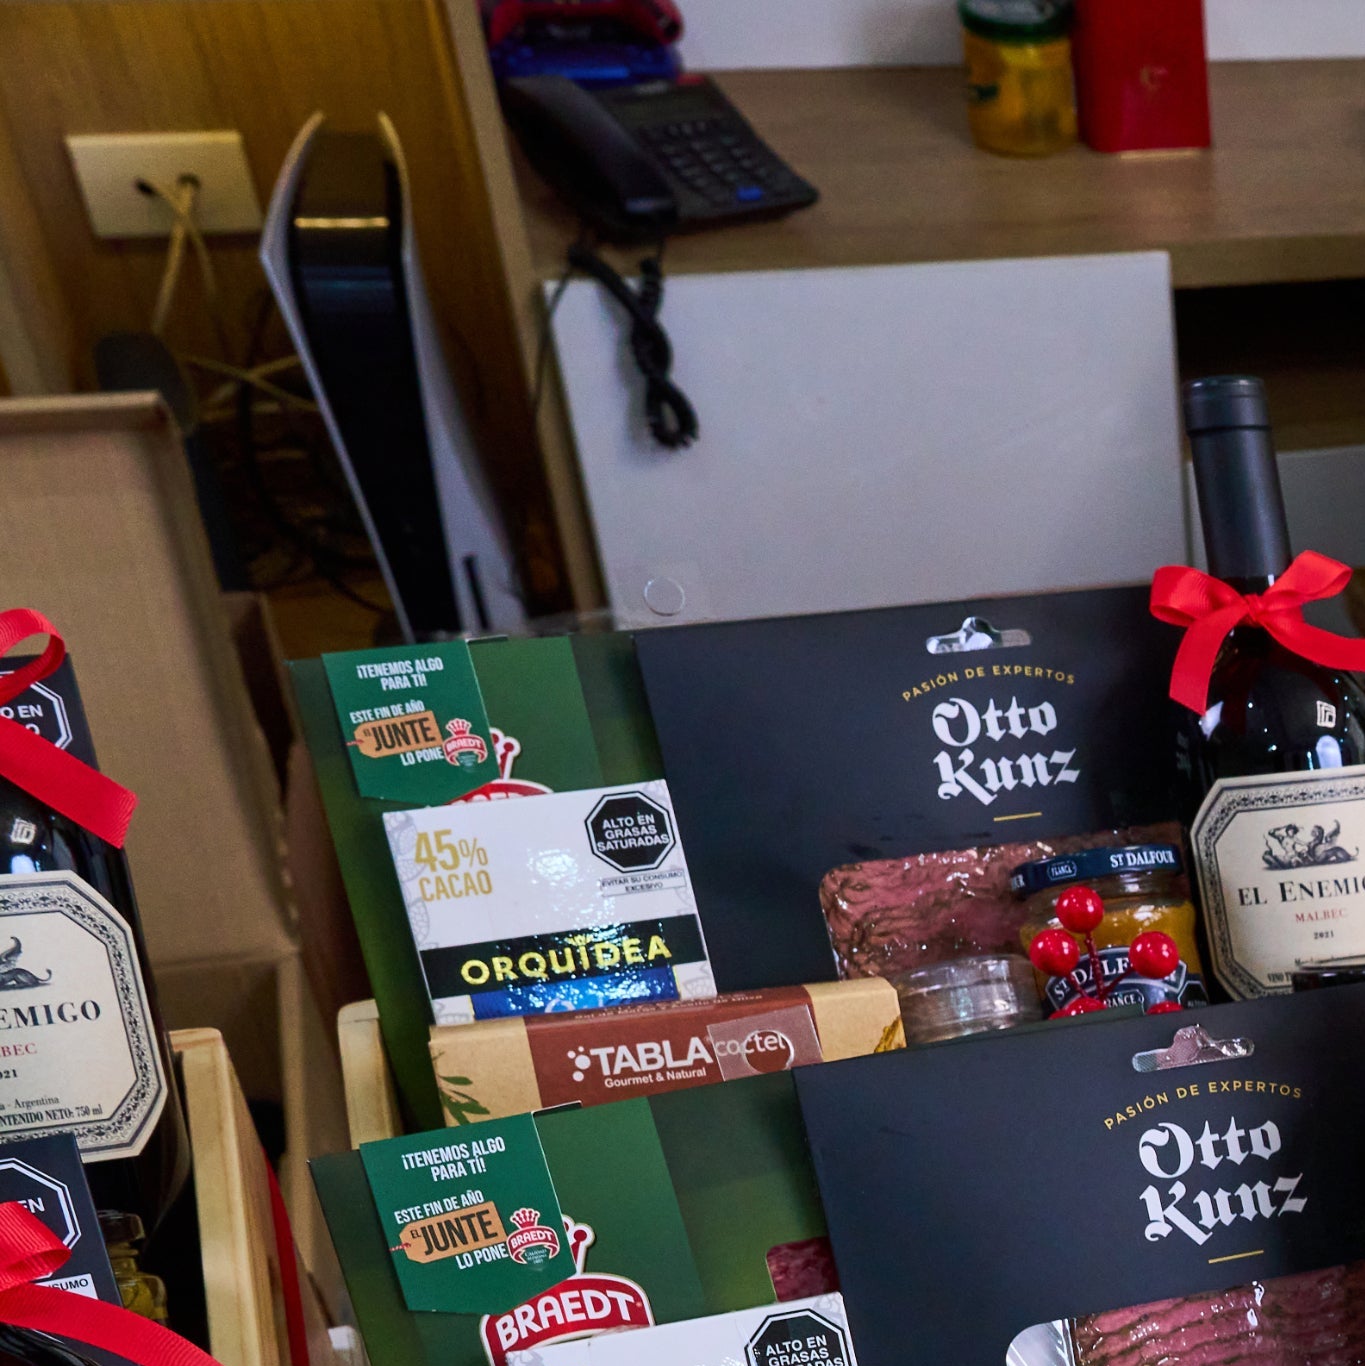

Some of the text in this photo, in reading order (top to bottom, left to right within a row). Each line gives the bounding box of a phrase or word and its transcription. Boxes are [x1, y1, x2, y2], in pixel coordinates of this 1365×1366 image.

[372, 719, 437, 754] JUNTE
[931, 695, 1058, 747] Otto
[932, 745, 1082, 806] Kunz
[415, 828, 489, 872] 45%
[419, 869, 493, 902] CACAO
[1238, 887, 1267, 907] EL
[586, 1031, 788, 1076] TABLA coctel
[1103, 1080, 1303, 1130] PASIÓN DE EXPERTOS
[471, 1136, 506, 1156] ALGO
[1138, 1115, 1282, 1180] Otto
[430, 1162, 467, 1182] PARA
[394, 1189, 485, 1225] ESTE FIN DE AÑO
[1138, 1172, 1309, 1246] Kunz
[409, 1209, 498, 1255] EL JUNTE
[510, 1230, 556, 1248] BRAEDT
[455, 1243, 509, 1270] LO PONE
[495, 1289, 636, 1350] BRAEDT
